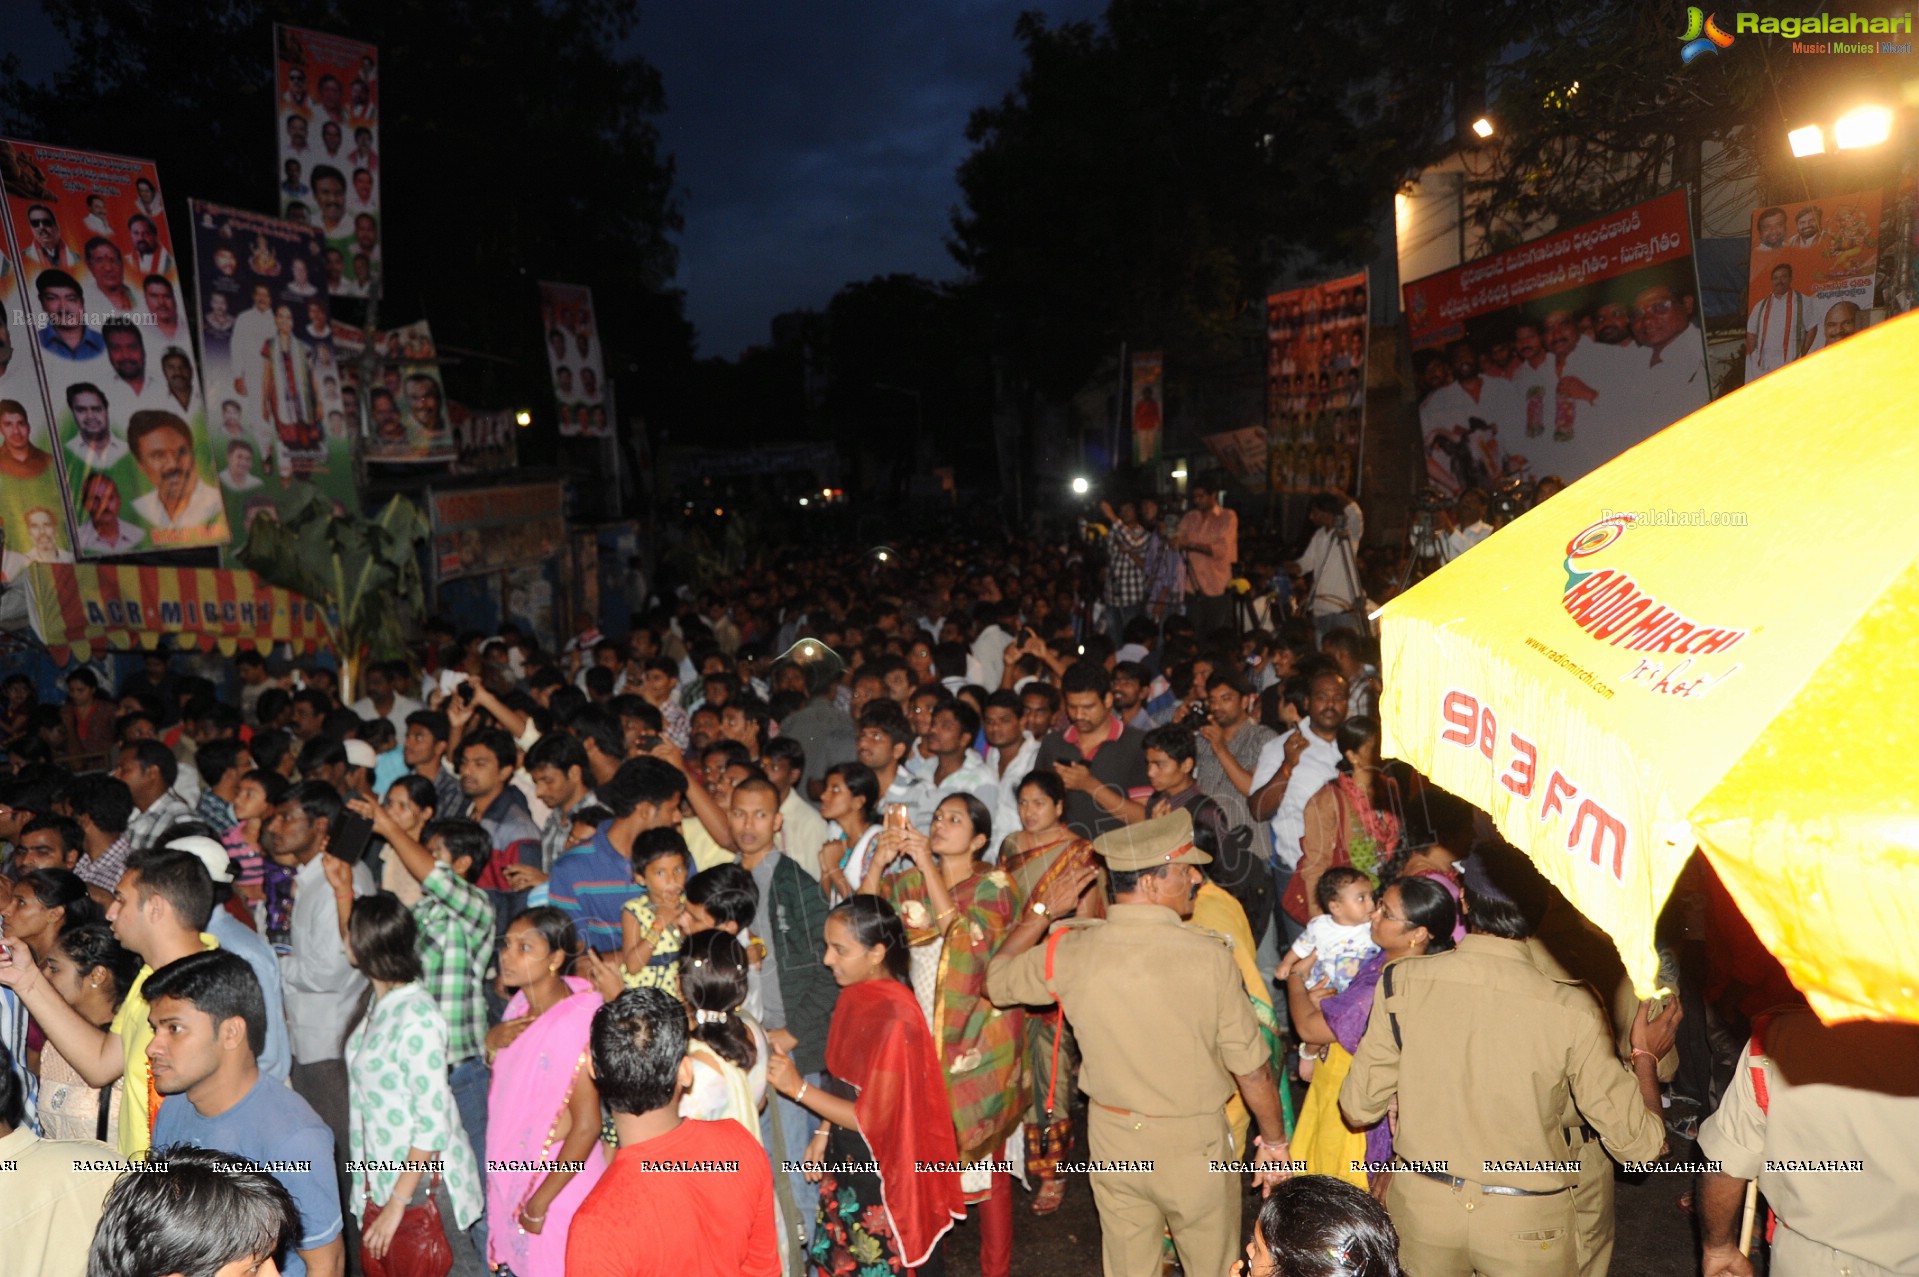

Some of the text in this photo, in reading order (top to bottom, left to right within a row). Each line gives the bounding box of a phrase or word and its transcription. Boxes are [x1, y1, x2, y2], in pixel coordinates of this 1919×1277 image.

[86, 601, 143, 625] ACR
[1561, 569, 1746, 655] RADIO MIRCHI
[1525, 636, 1615, 700] www.radiomirchi.com
[1540, 770, 1627, 882] FM
